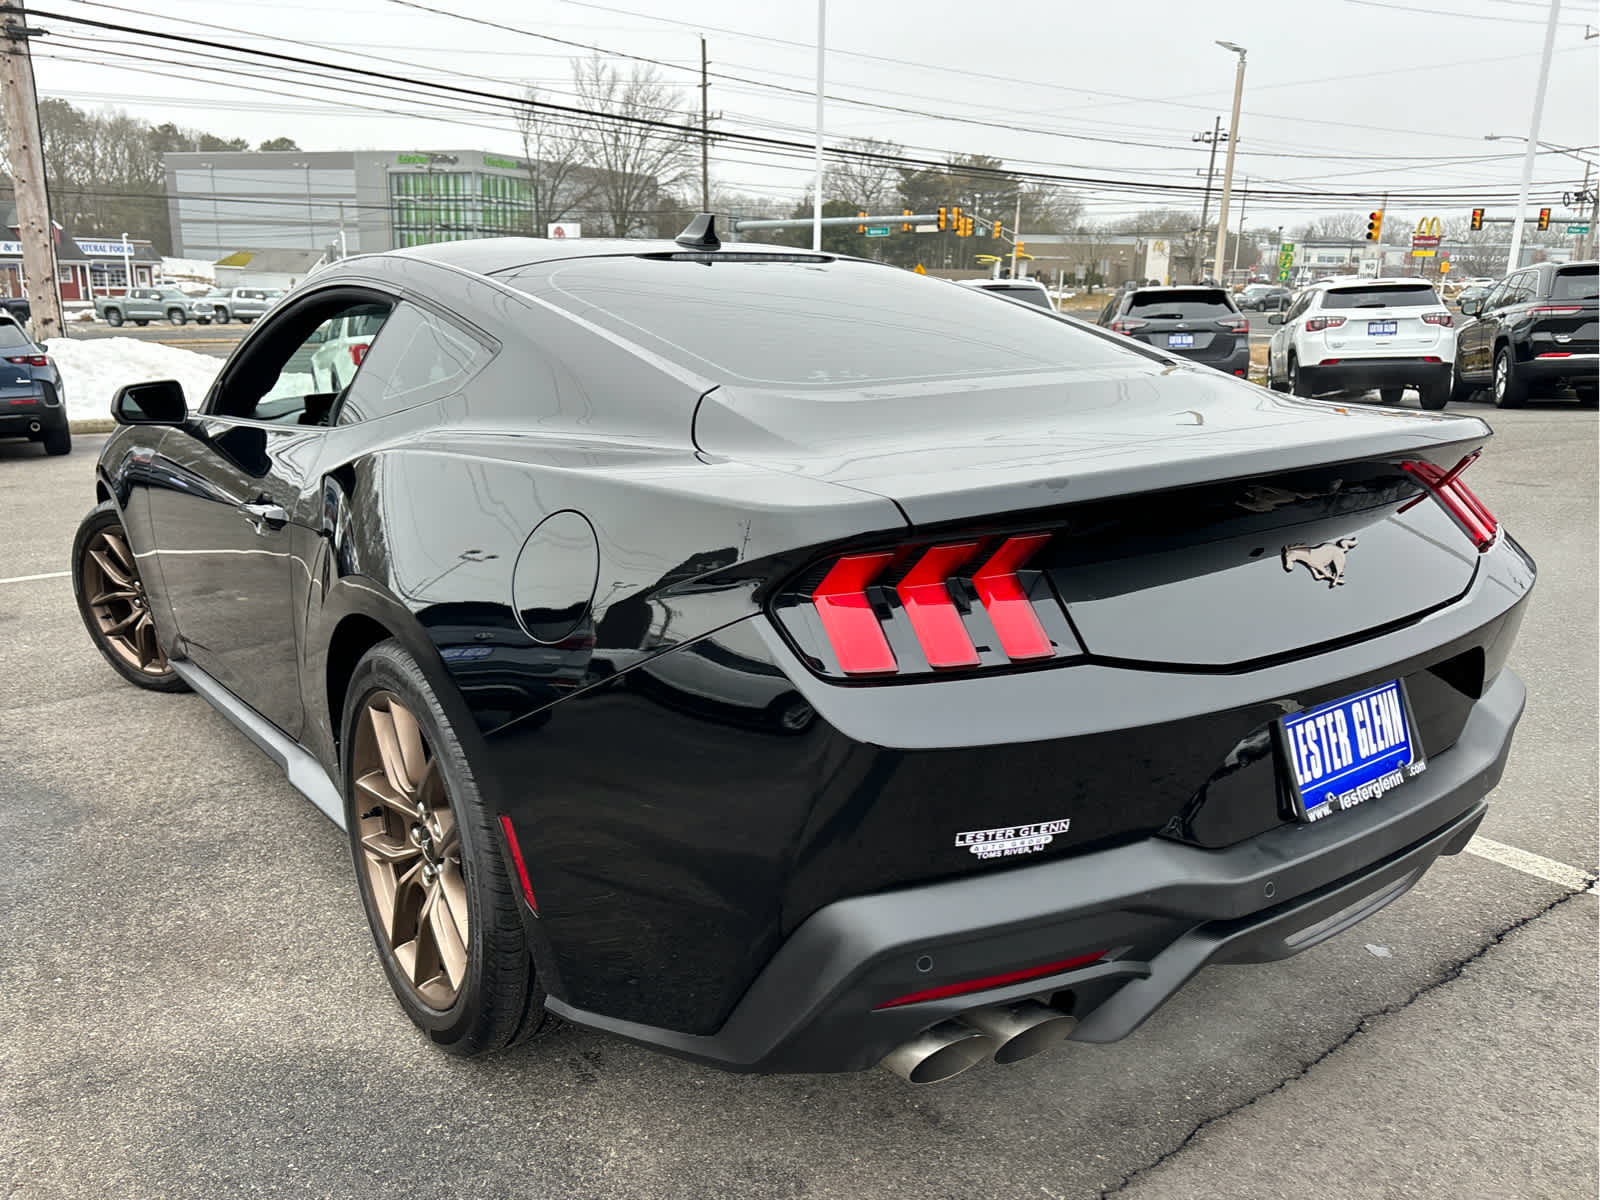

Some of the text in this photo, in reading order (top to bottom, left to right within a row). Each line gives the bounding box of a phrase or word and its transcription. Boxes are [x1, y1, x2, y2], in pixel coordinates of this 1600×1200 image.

[109, 245, 133, 254] FOOS
[1287, 688, 1406, 786] LESTER GLENN
[956, 821, 1070, 845] LESTER GLENN
[973, 842, 1005, 853] AUTO
[977, 843, 1045, 859] TOMS RIVER, NJ
